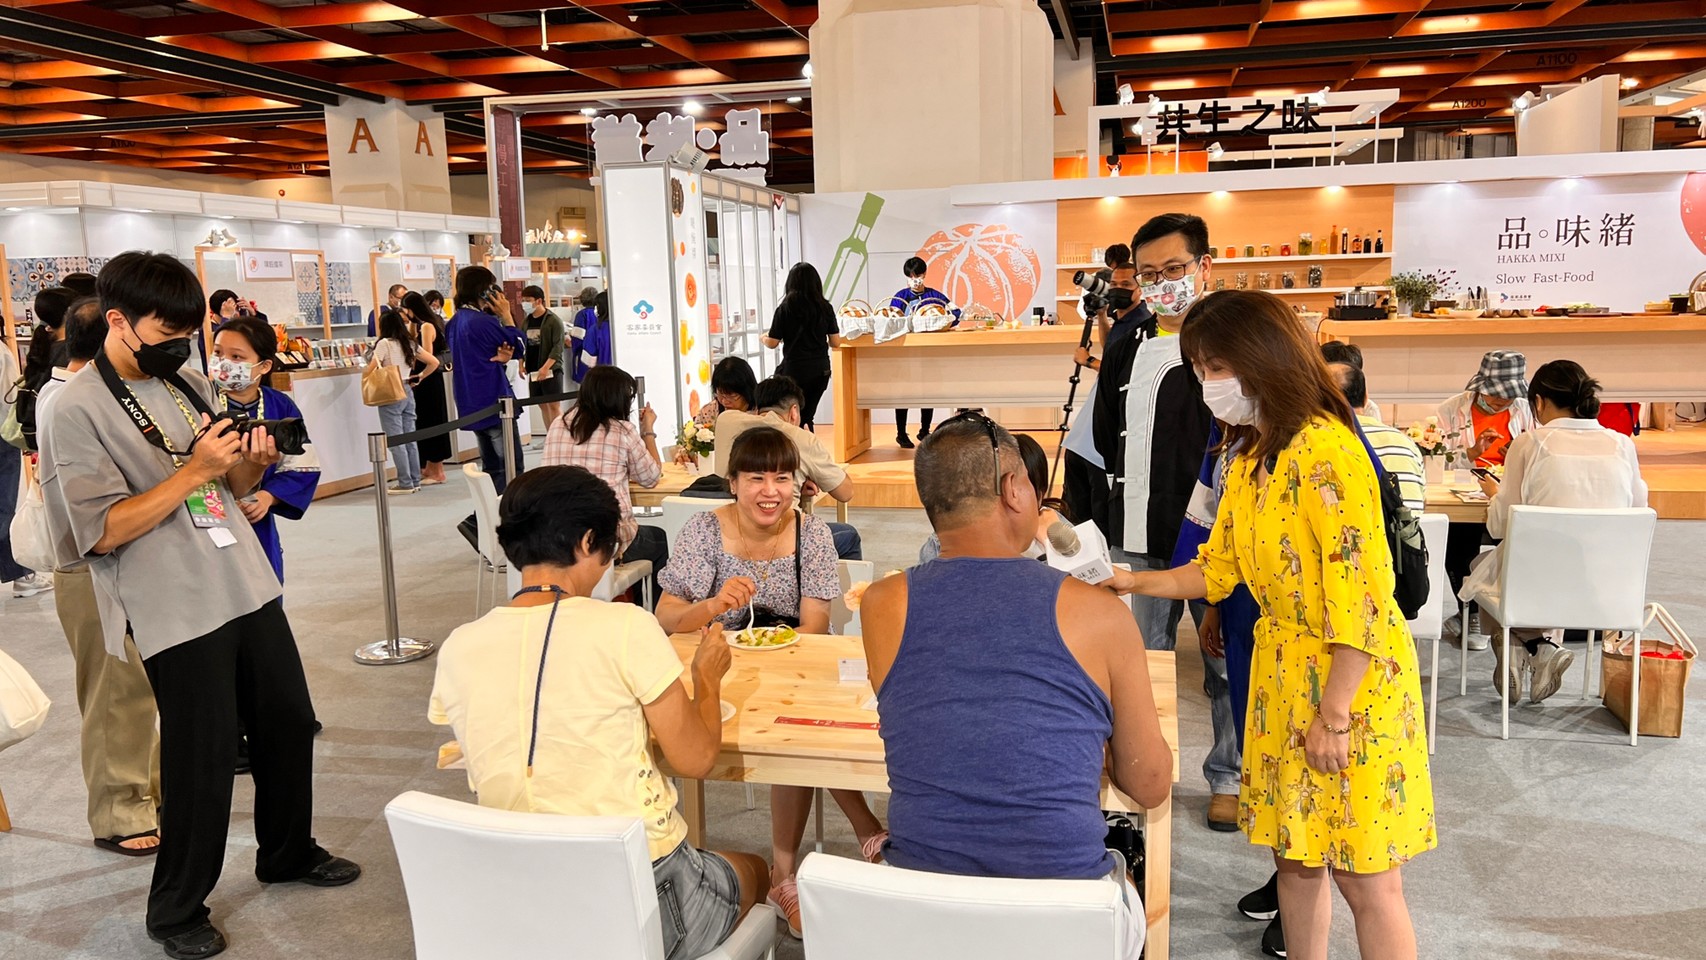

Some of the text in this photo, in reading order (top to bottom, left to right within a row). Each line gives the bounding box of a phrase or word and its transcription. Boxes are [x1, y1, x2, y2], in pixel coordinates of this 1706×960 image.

[1536, 52, 1578, 67] A1100
[1452, 98, 1487, 109] A1200
[1155, 96, 1320, 139] 共生之味
[348, 117, 380, 154] A
[414, 120, 434, 157] A
[1497, 253, 1566, 264] HAKKA MIXI
[1496, 270, 1595, 285] Slow Fast-Food
[121, 397, 149, 427] SONY
